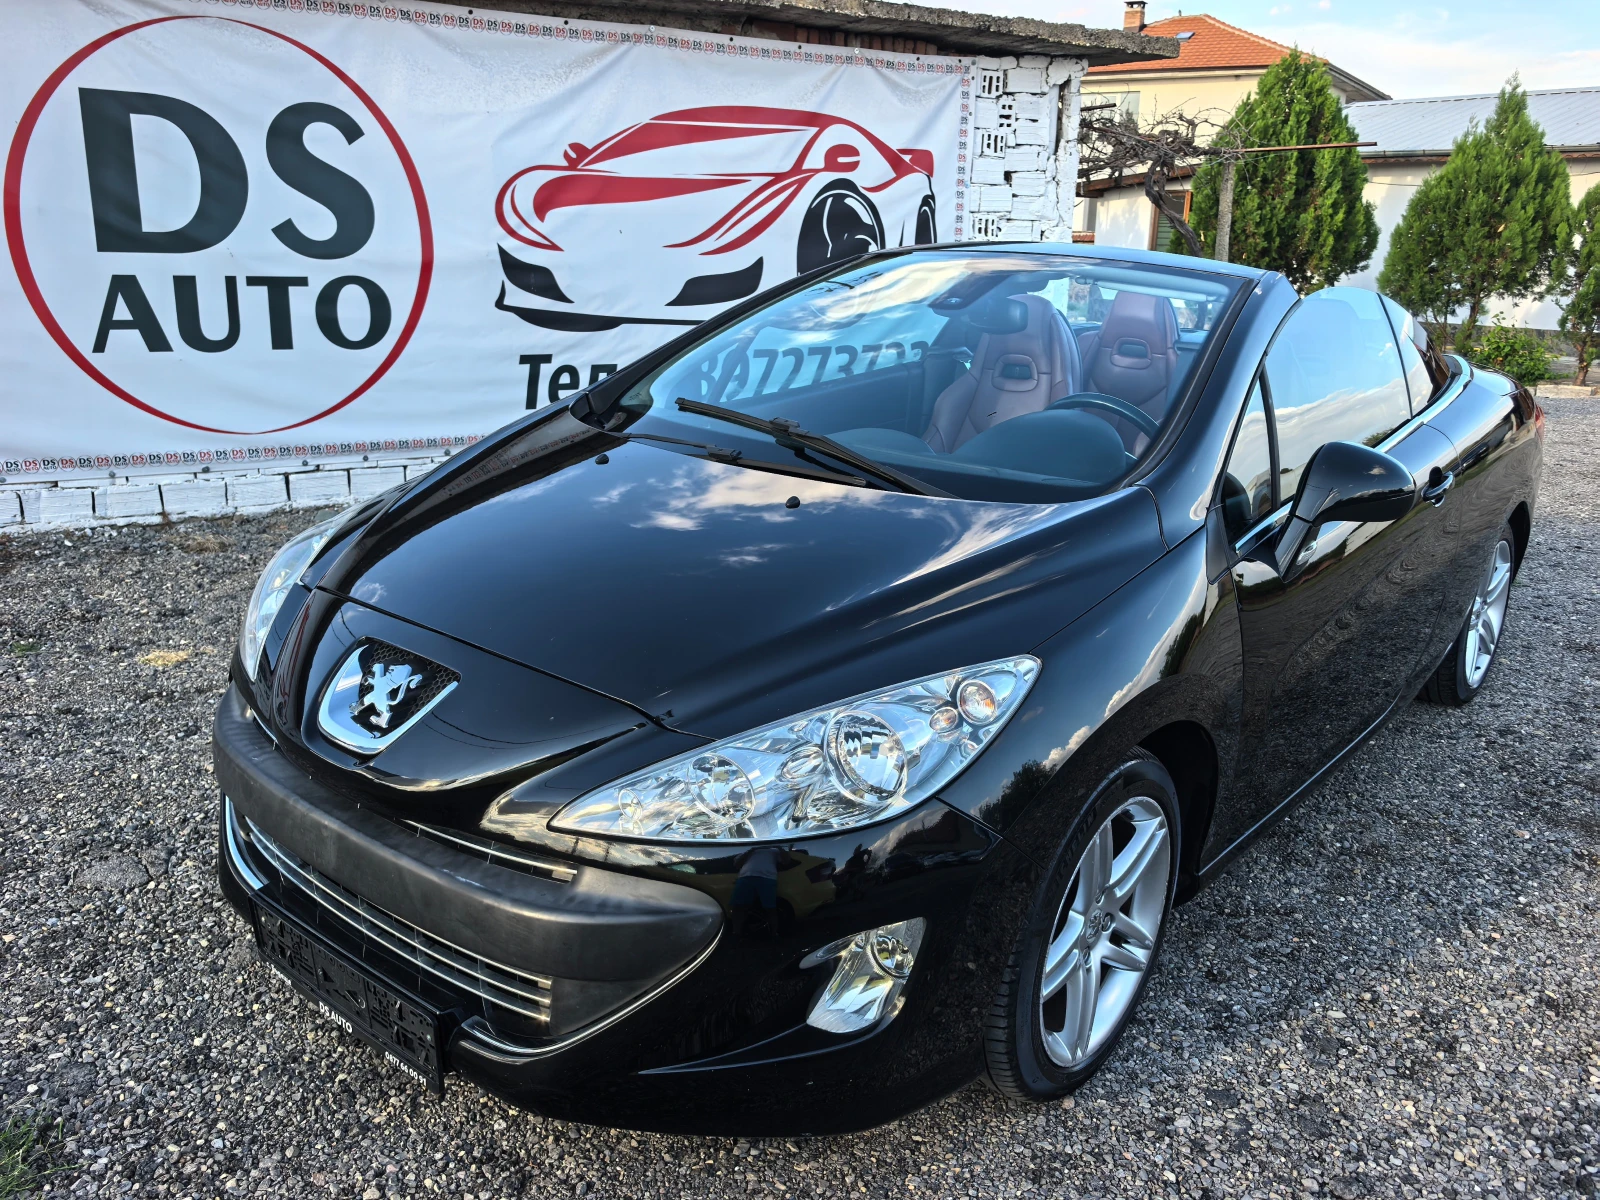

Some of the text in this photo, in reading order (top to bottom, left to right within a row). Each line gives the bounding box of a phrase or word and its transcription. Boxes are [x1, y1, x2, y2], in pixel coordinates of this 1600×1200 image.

[78, 87, 375, 260] DS
[92, 274, 392, 353] AUTO
[318, 1001, 352, 1033] DS AUTO
[400, 1062, 408, 1073] 66
[409, 1068, 418, 1080] 00
[419, 1075, 426, 1086] 91
